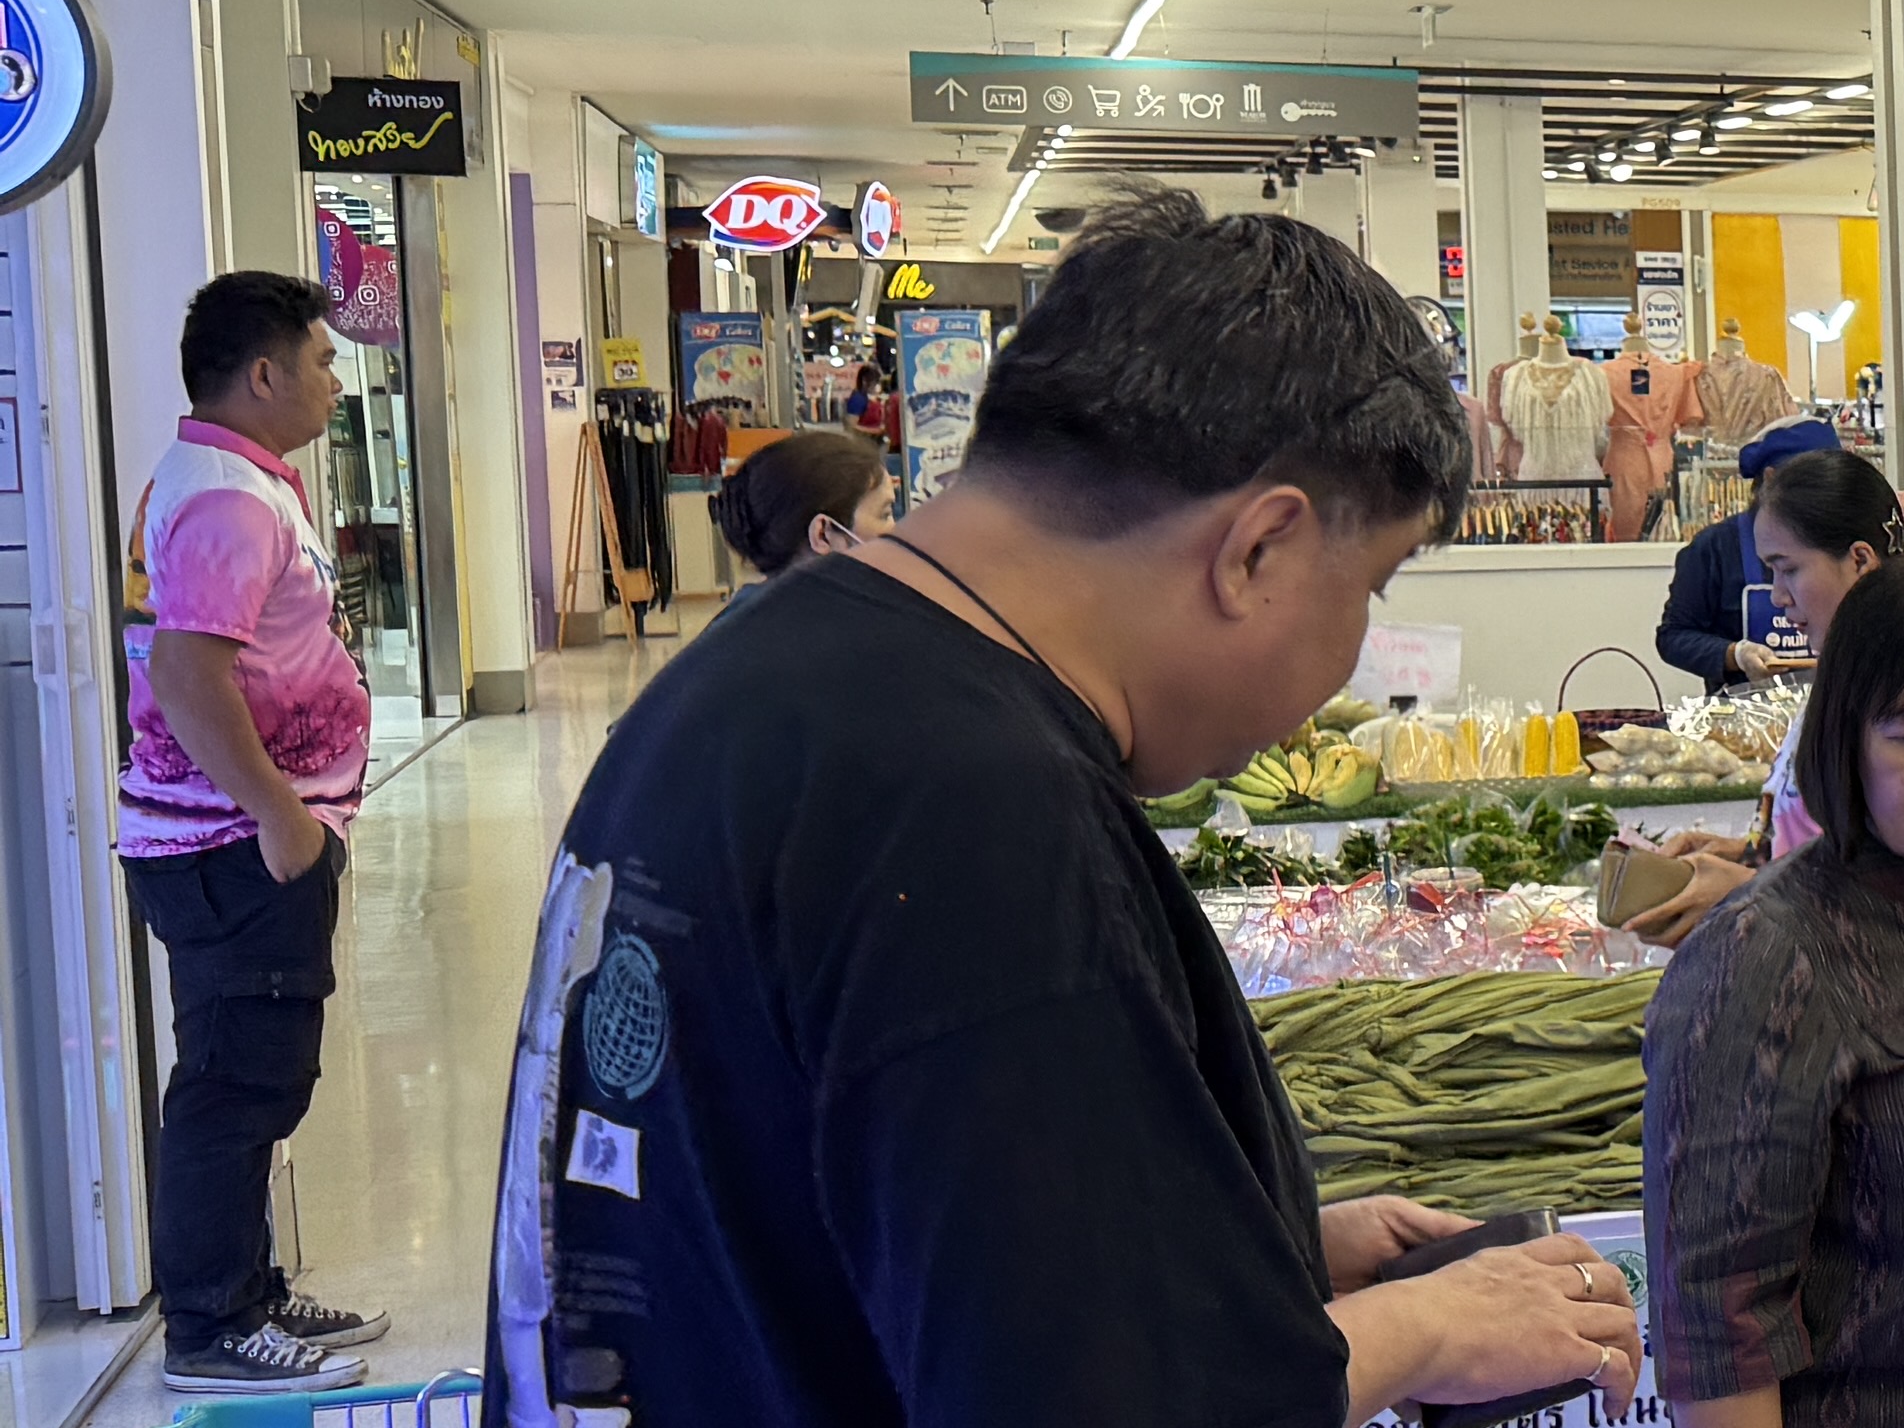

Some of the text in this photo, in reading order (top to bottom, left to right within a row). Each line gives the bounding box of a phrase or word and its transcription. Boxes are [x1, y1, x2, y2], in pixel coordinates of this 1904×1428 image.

[367, 87, 444, 109] ห้างทอง
[988, 92, 1021, 107] ATM
[726, 193, 803, 230] DQ
